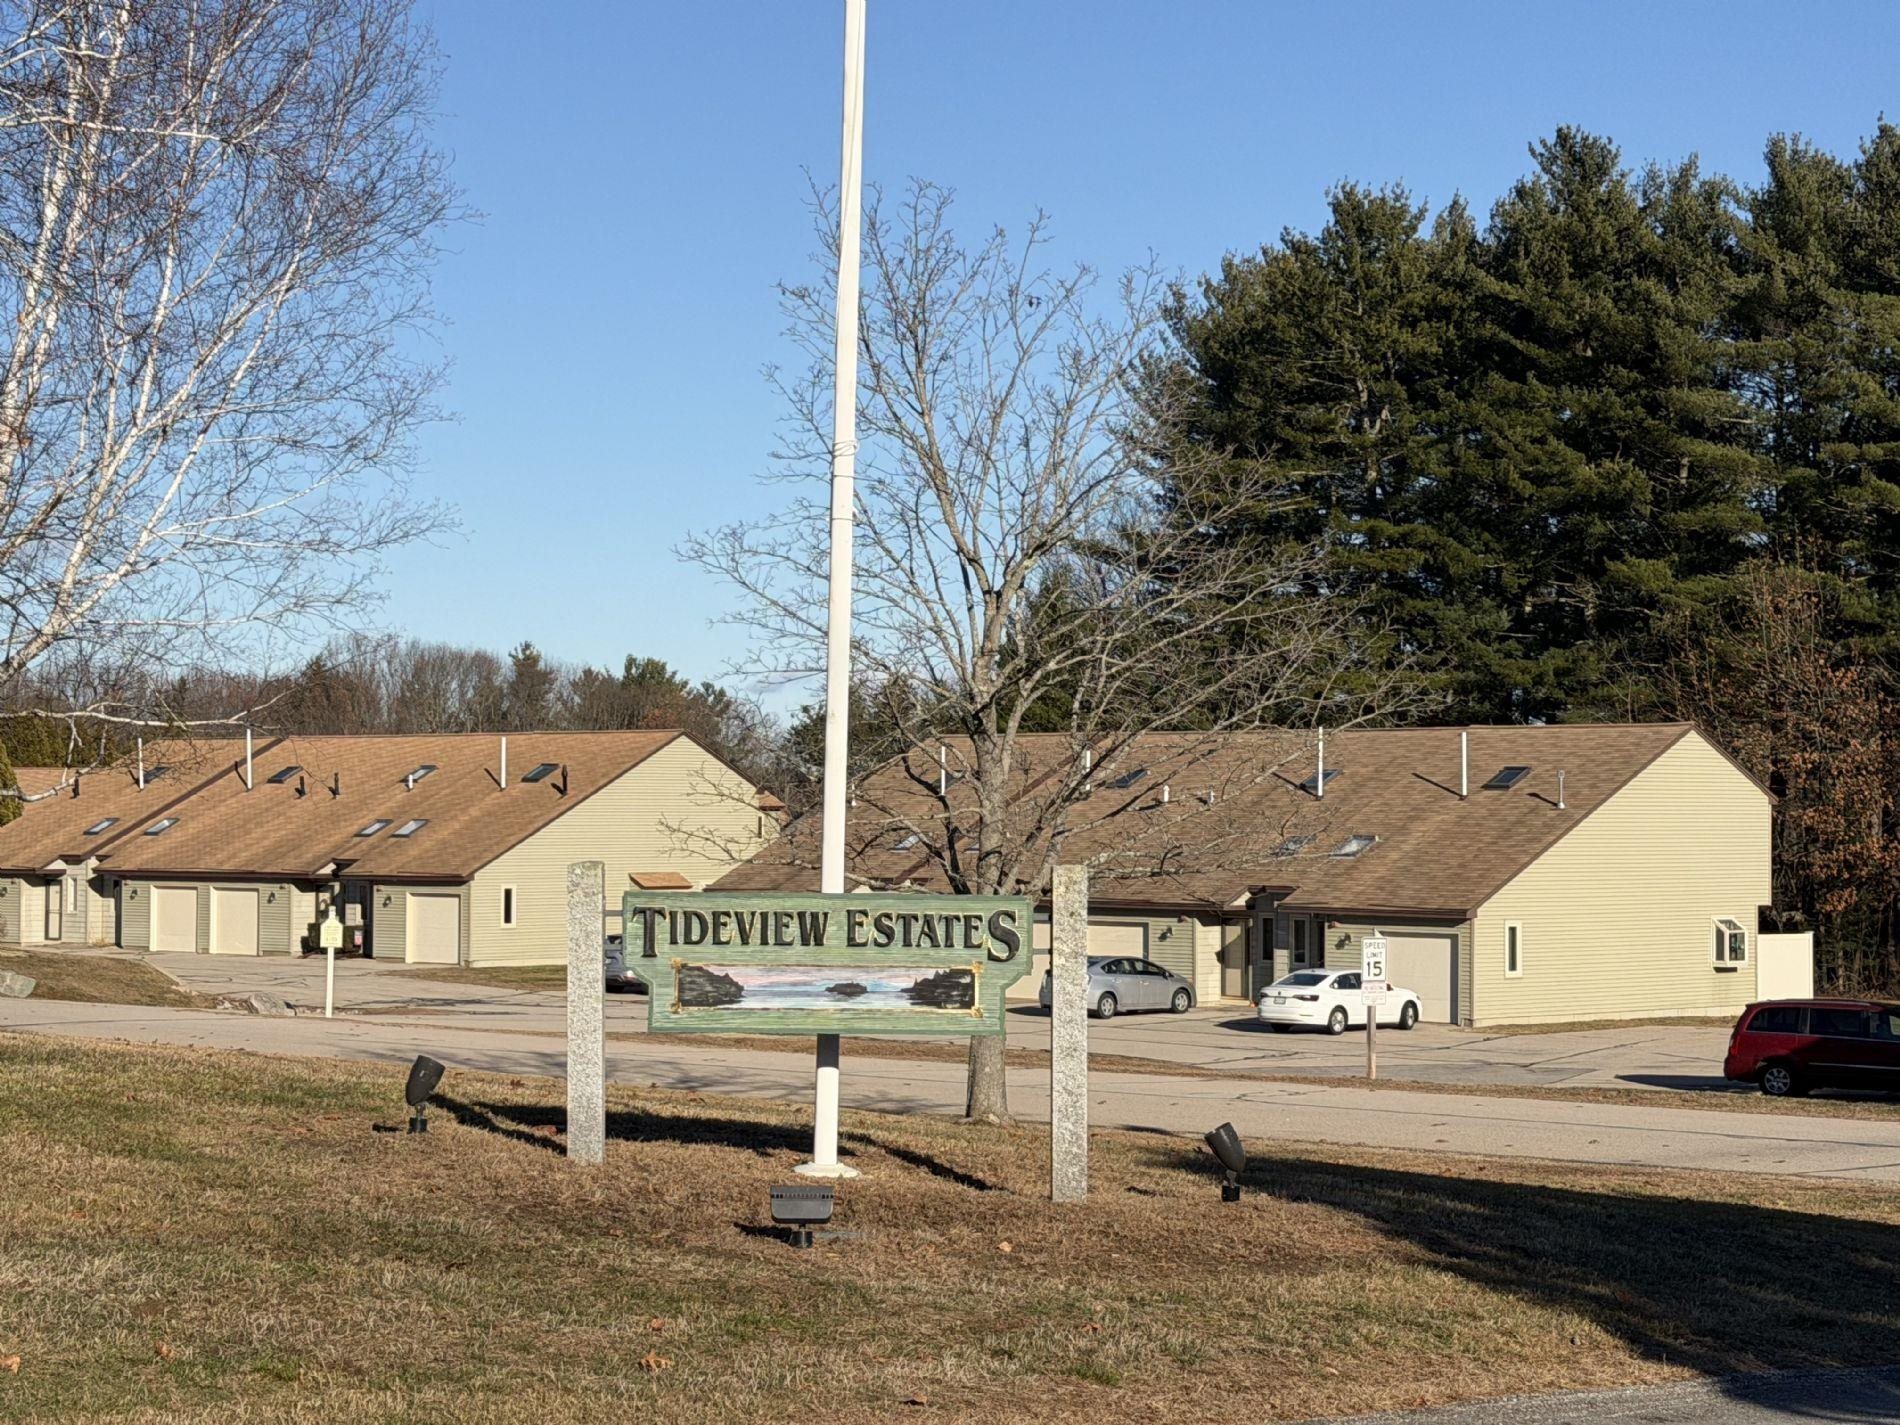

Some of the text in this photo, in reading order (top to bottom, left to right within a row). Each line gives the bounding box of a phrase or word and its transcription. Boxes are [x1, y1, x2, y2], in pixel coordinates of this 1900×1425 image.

[632, 906, 1021, 962] TIDEVIEW ESTATES
[1364, 941, 1386, 950] SPEED
[1366, 951, 1383, 959] LIMIT
[1366, 961, 1383, 977] 15
